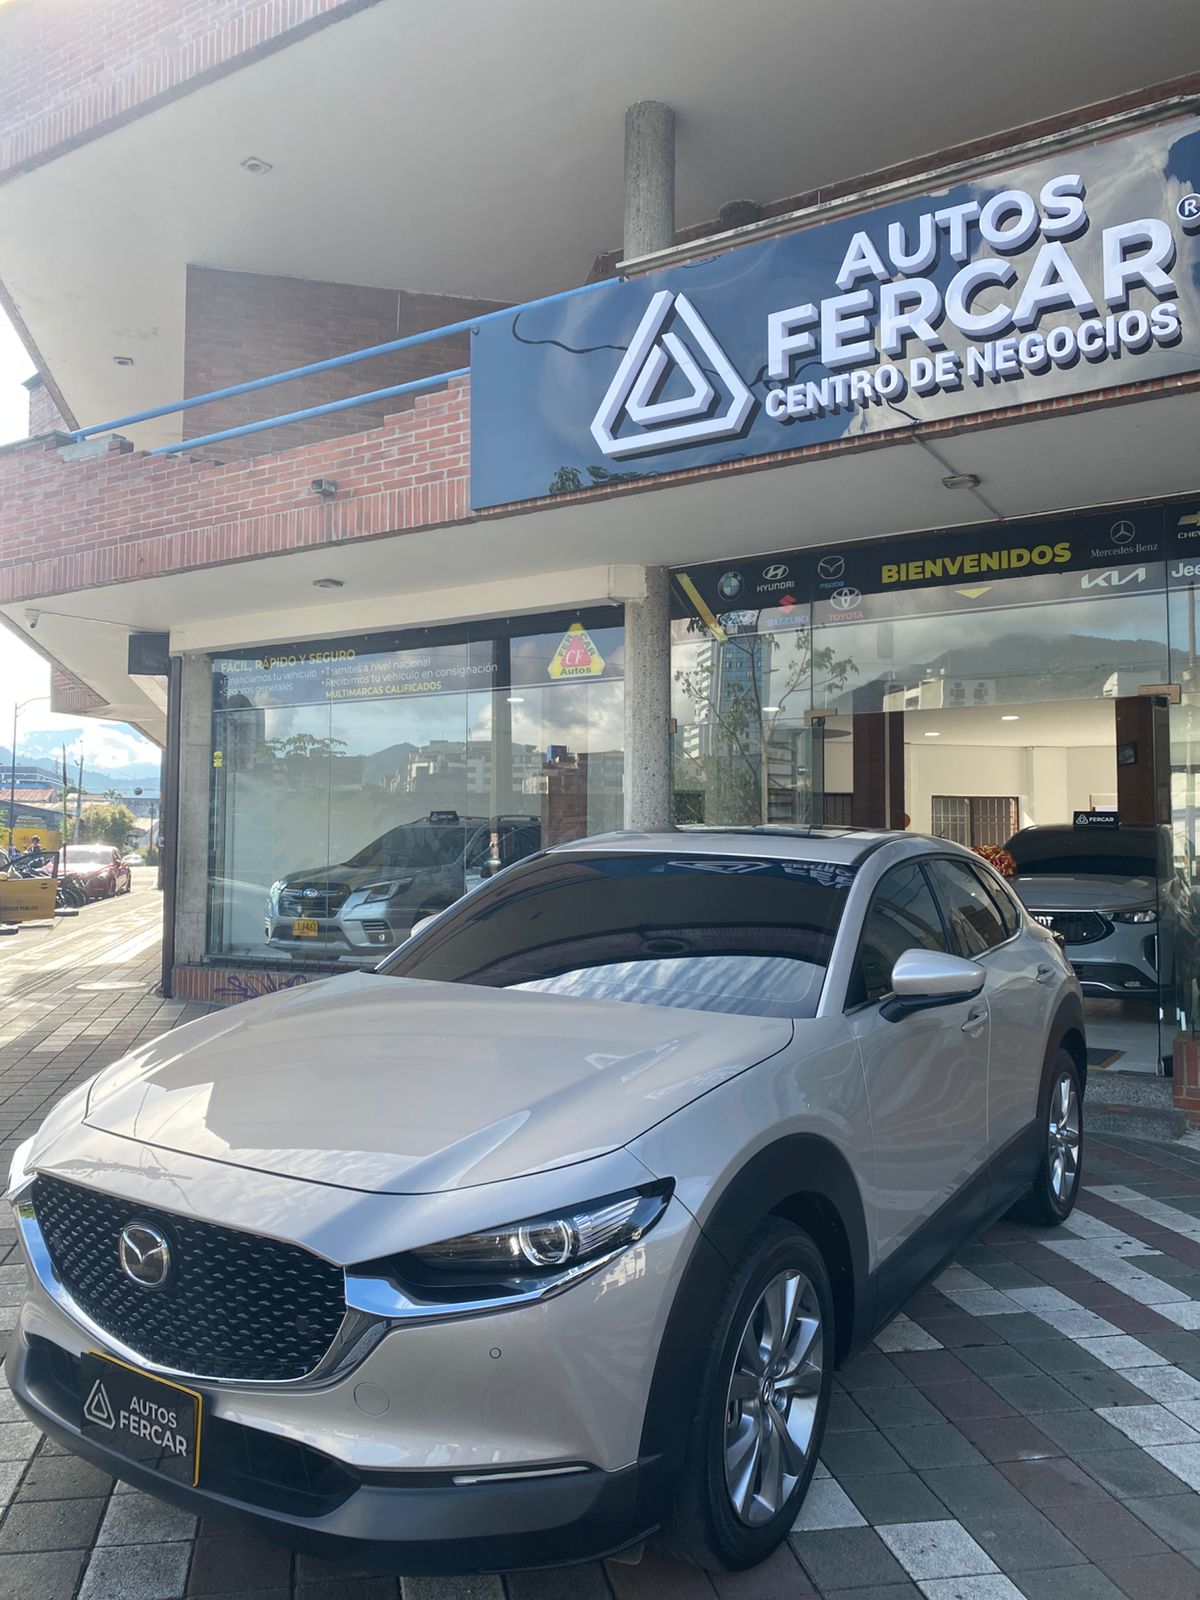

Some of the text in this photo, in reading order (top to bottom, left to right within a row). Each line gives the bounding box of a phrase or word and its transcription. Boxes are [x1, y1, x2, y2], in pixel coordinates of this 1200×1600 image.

[836, 174, 1087, 290] AUTOS
[767, 218, 1175, 381] FERCAR
[766, 302, 1181, 420] CENTRO DE NEGOCIOS
[1090, 543, 1158, 558] Mercedes-Benz
[881, 542, 1072, 583] BIENVENIDOS
[756, 580, 795, 592] HYUNDAI
[819, 580, 845, 589] mazda
[1081, 567, 1146, 589] KIA
[767, 614, 809, 627] SUZUKI
[828, 611, 864, 622] TOYOTA
[221, 649, 356, 673] FÁCIL, RÁPIDO Y SEGURO
[363, 665, 369, 673] a
[371, 661, 392, 672] nivel
[393, 656, 431, 670] nacional
[560, 666, 592, 676] Autos
[273, 673, 282, 682] tu
[326, 674, 370, 687] Recibimos
[371, 674, 381, 684] tu
[421, 669, 433, 679] en
[435, 662, 498, 678] consignación
[325, 681, 442, 699] MULTIMARCAS CALIFICADOS
[130, 1396, 177, 1429] AUTOS
[119, 1410, 187, 1456] FERCAR
